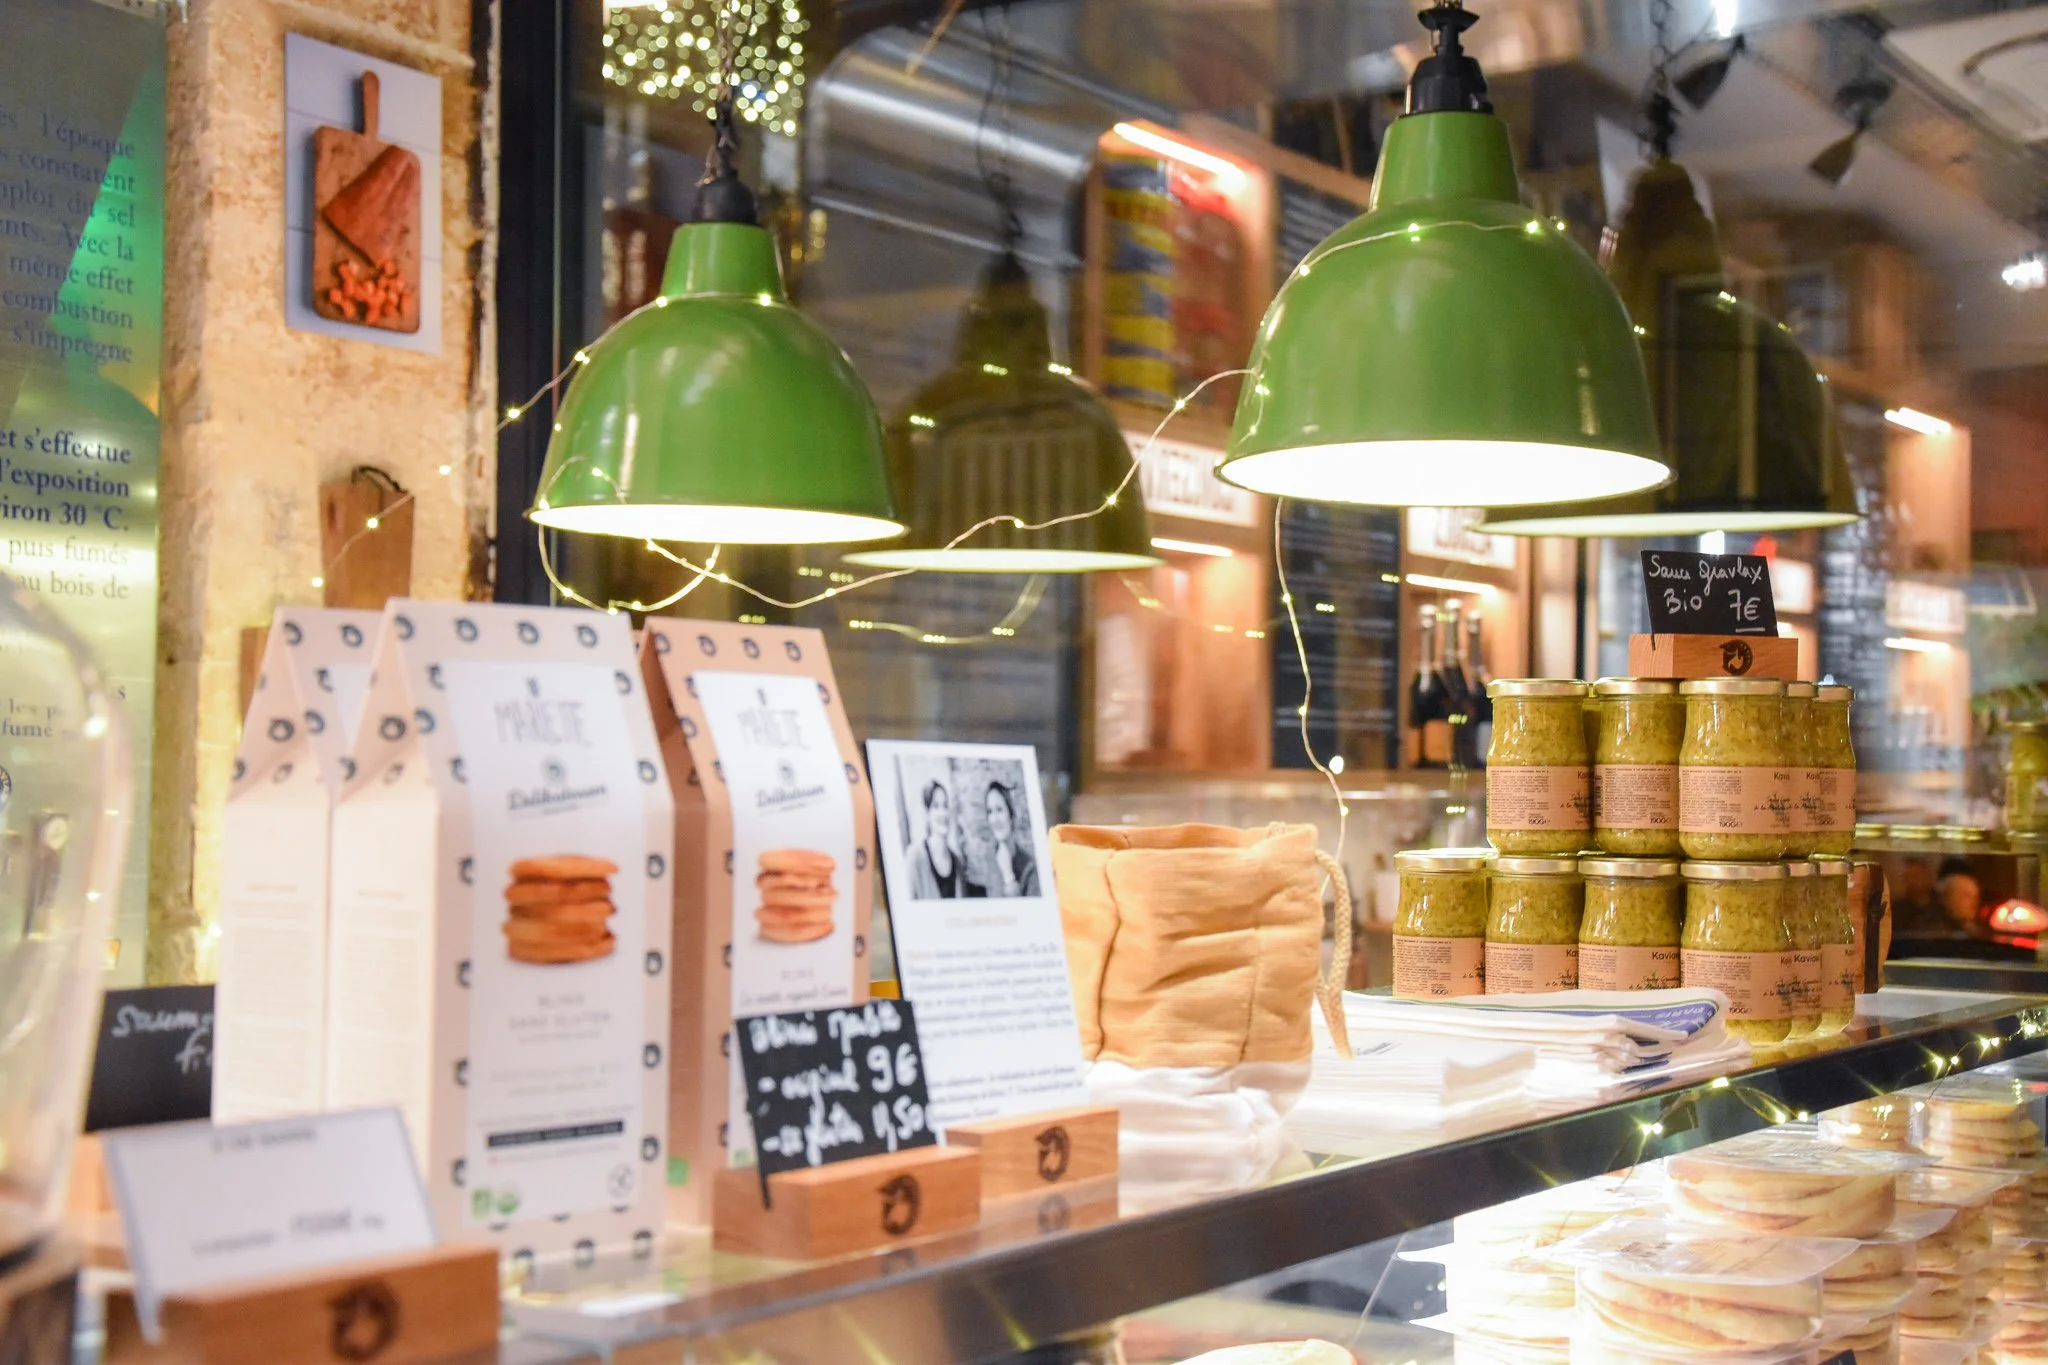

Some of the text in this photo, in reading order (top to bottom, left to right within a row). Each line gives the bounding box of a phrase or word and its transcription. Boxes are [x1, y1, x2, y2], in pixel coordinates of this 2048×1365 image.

[107, 202, 135, 228] sel
[116, 235, 134, 262] la
[86, 265, 135, 297] effet
[3, 289, 134, 330] combustion
[24, 426, 132, 465] s'effectue
[0, 495, 50, 523] iron
[60, 501, 87, 527] 30
[9, 535, 129, 565] puis fumés
[51, 569, 94, 598] bois
[103, 575, 129, 600] de
[1728, 588, 1761, 622] 7€
